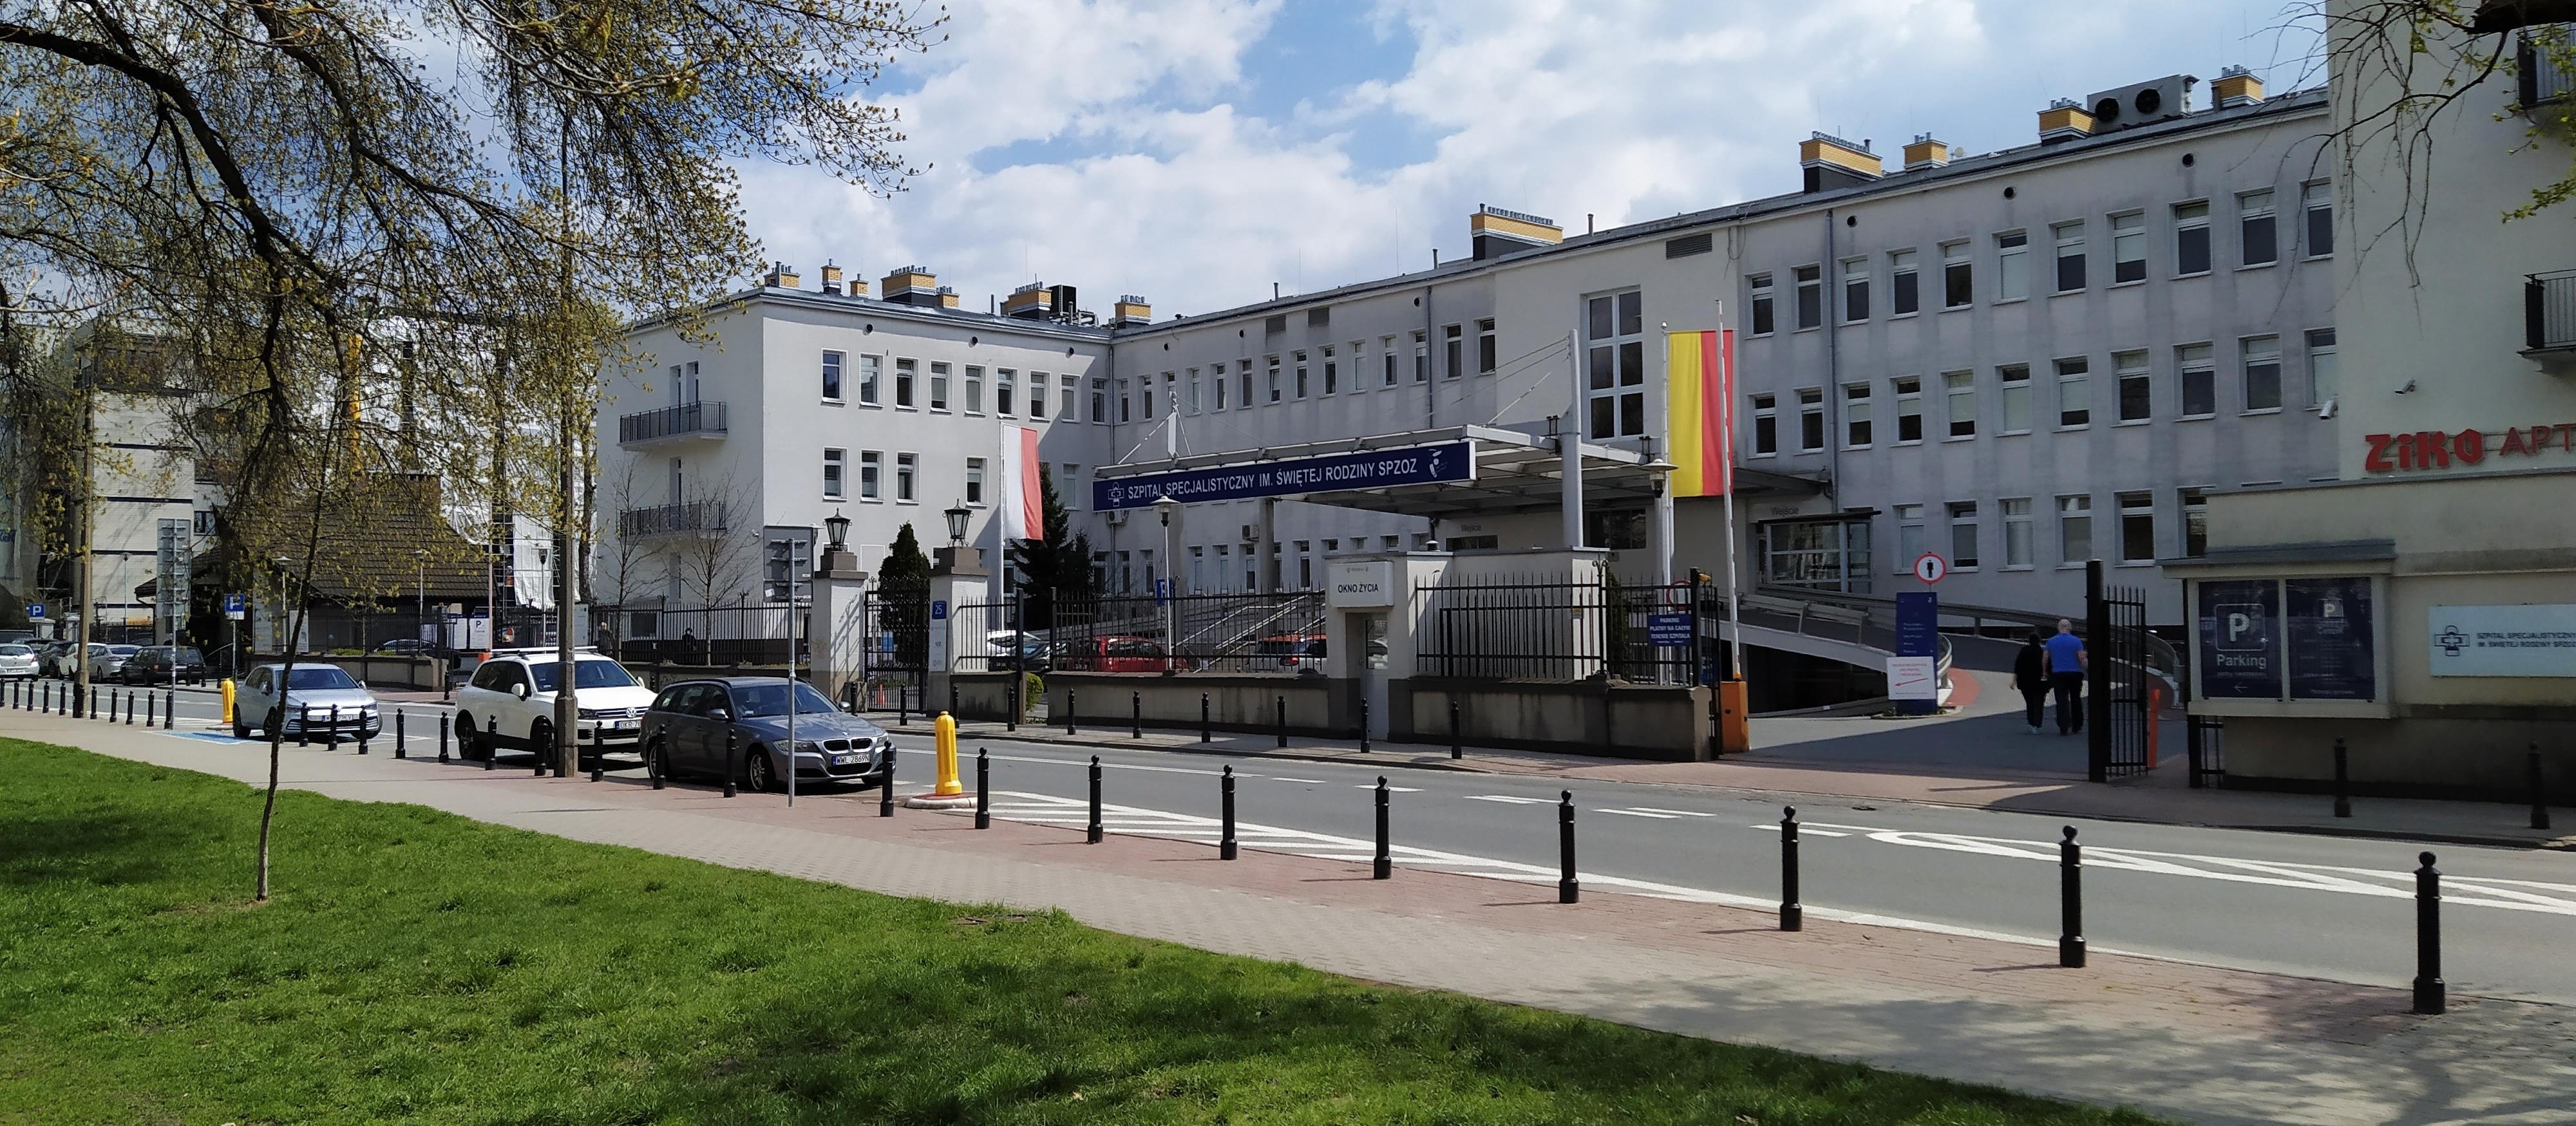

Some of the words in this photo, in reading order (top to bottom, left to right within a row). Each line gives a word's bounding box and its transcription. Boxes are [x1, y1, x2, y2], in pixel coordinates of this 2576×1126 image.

[1128, 483, 1163, 500] SZPITAL
[1166, 474, 1255, 496] SPECJALISTYCZNY
[1259, 473, 1273, 487] IM.
[1276, 467, 1322, 487] ŚWIĘTEJ
[1325, 462, 1375, 480] RODZINY
[1378, 458, 1417, 476] SPZOZ
[1338, 584, 1358, 593] OKNO
[1359, 582, 1379, 592] ŻYCIA
[33, 605, 42, 616] P
[934, 605, 943, 615] 25
[476, 620, 482, 628] P
[2229, 612, 2251, 642] P
[2217, 654, 2267, 670] Parking
[837, 756, 849, 764] WWL
[851, 754, 869, 763] 2869N
